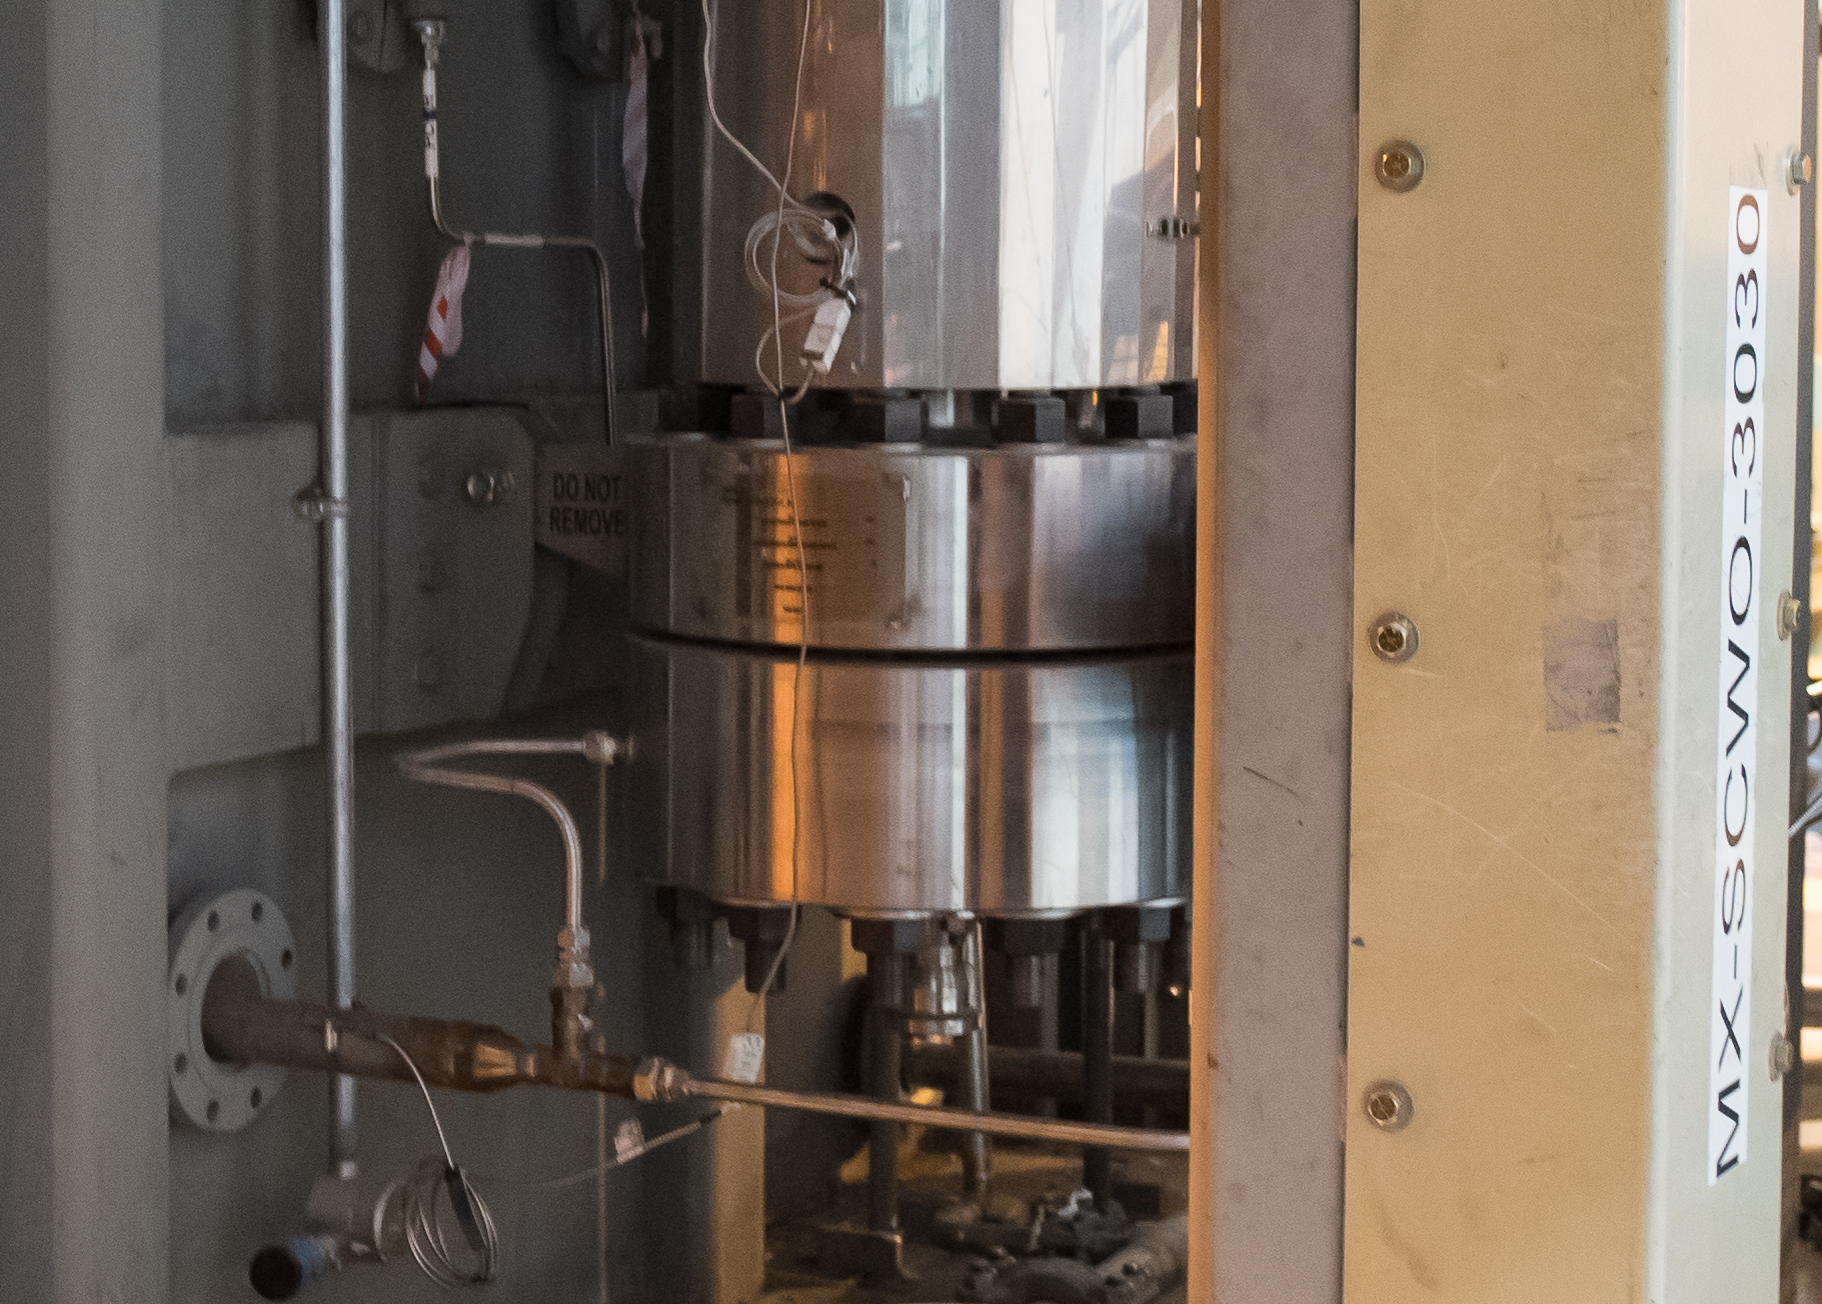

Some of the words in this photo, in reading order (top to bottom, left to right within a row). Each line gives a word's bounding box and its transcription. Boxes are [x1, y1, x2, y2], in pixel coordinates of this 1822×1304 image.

[553, 473, 579, 501] DO
[584, 474, 621, 504] NOT
[549, 505, 625, 537] REMOVE
[1716, 193, 1760, 1178] MX-SCWO-3030
